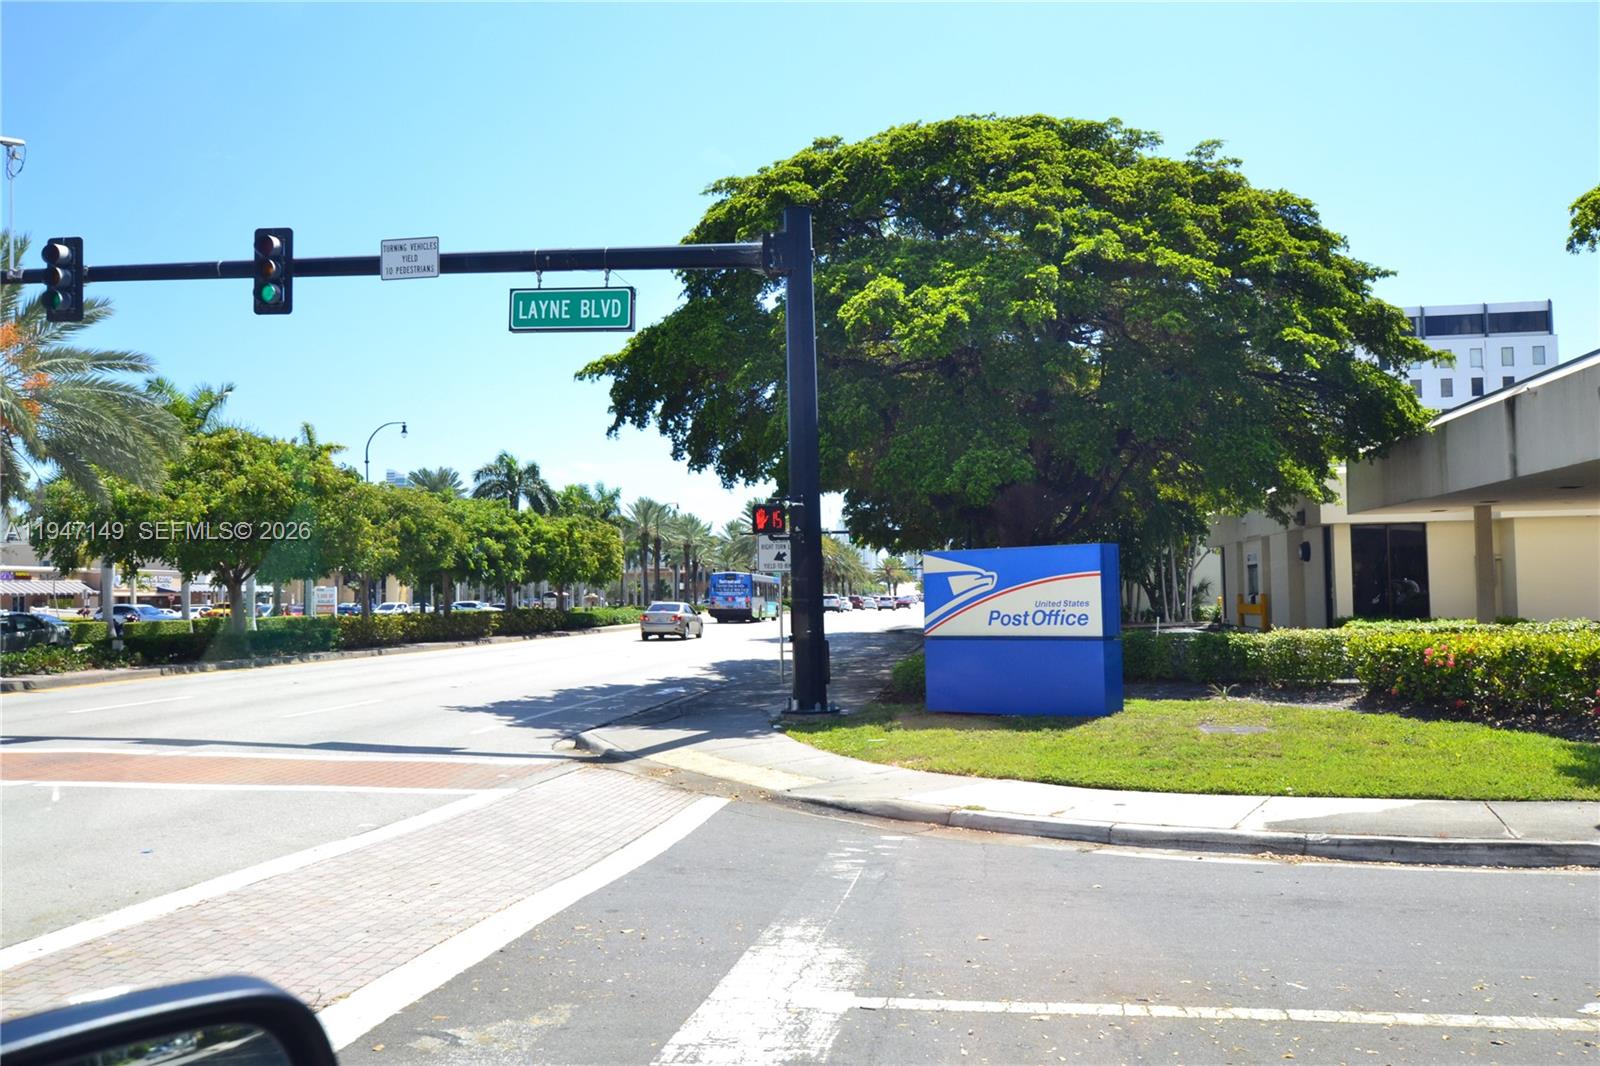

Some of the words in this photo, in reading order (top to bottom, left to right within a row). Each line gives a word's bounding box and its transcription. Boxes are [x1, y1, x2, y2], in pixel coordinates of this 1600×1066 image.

[383, 244, 407, 252] TURNING
[410, 241, 437, 251] VEHICLES
[402, 254, 418, 263] YIELD
[396, 265, 434, 275] PEDESTRIANS
[519, 300, 571, 319] LAYNE
[580, 298, 621, 318] BLVD
[772, 510, 783, 528] 15
[1034, 600, 1062, 608] United
[1063, 600, 1090, 608] States
[988, 610, 1030, 626] Post
[1032, 609, 1089, 626] Office
